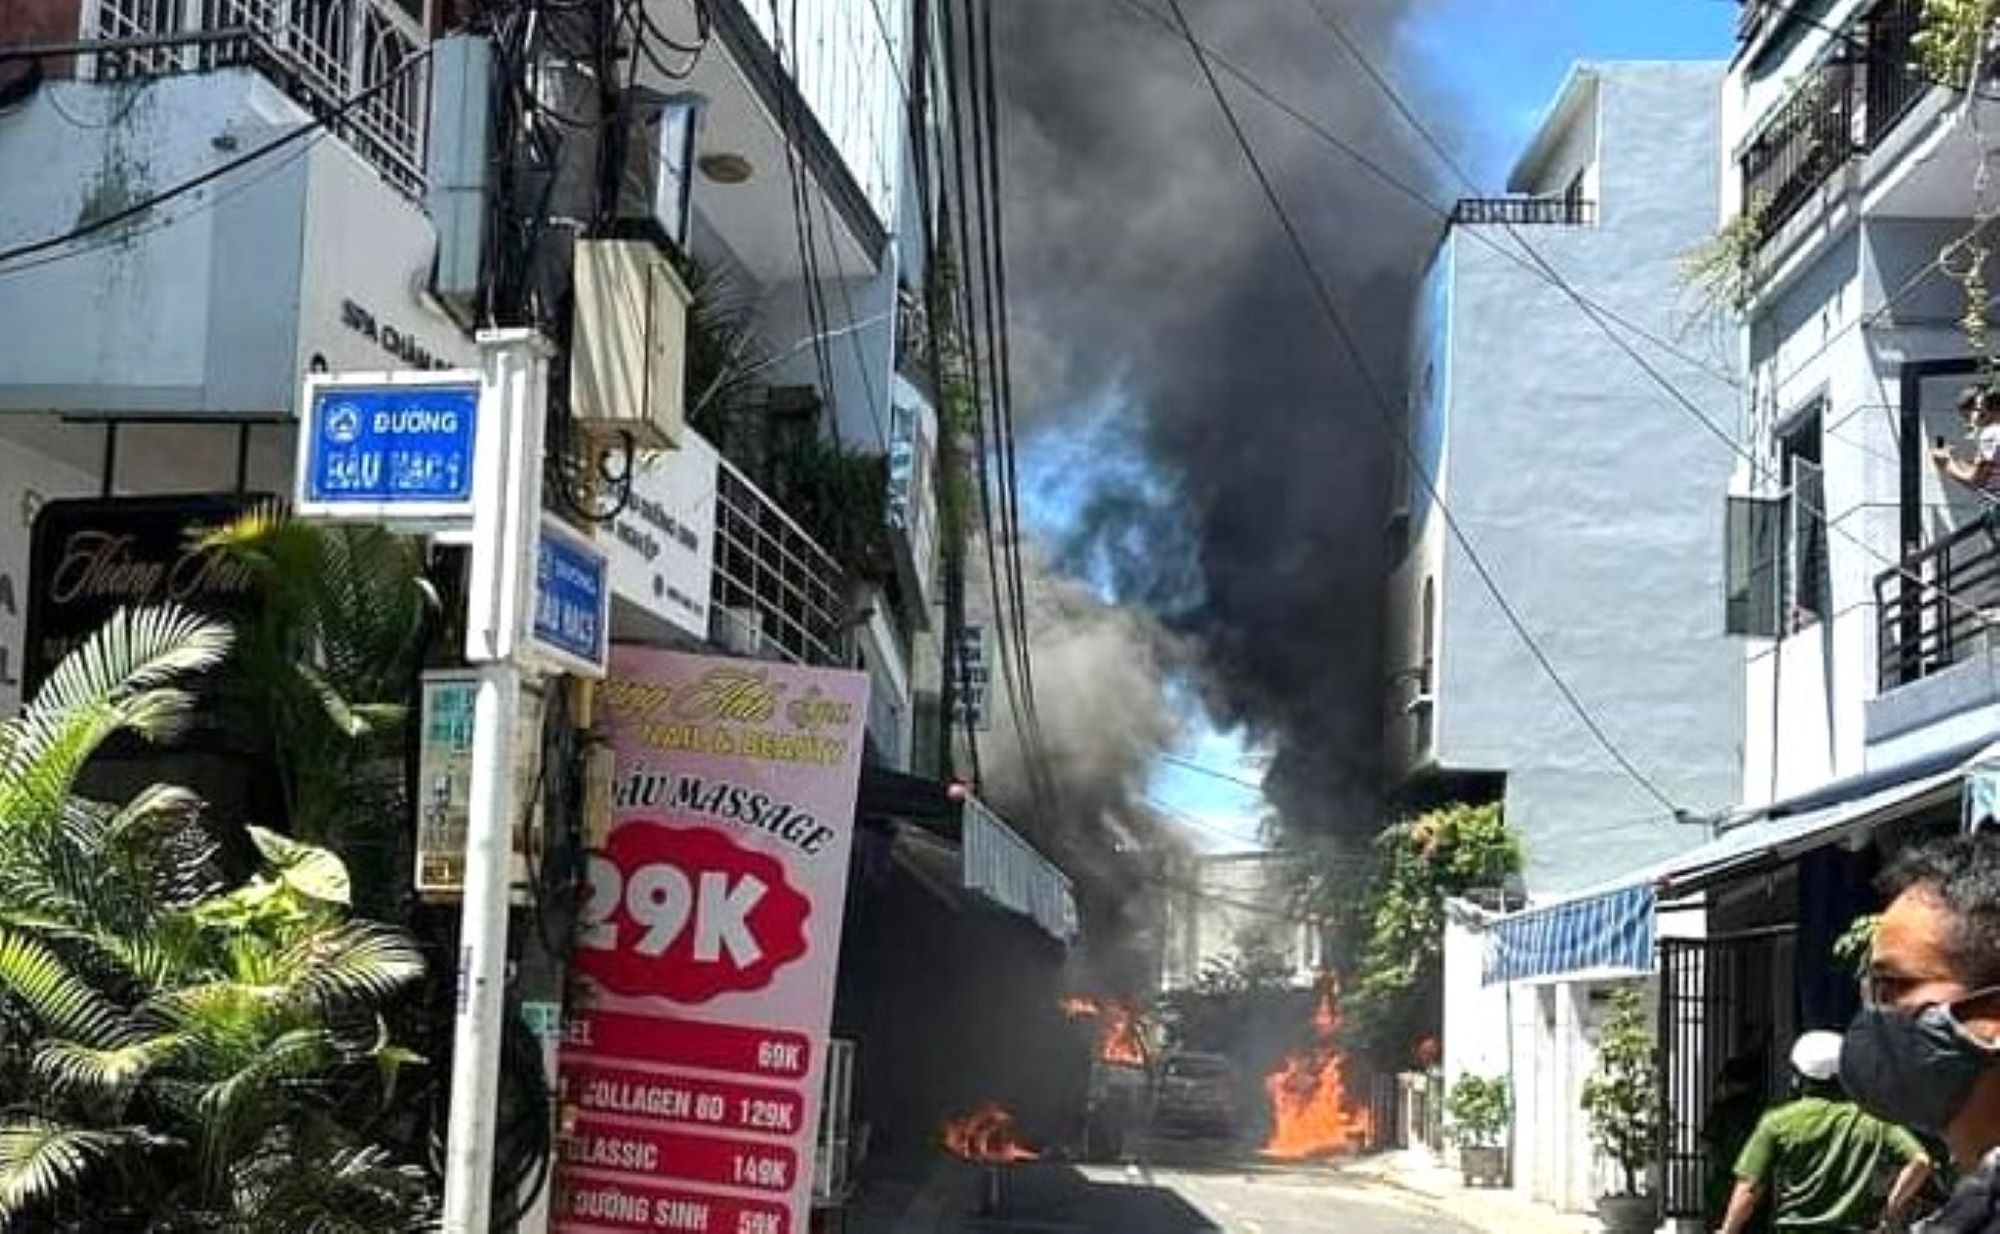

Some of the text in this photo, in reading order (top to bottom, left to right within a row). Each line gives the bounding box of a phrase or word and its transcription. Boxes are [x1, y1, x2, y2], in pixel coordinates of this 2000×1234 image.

[669, 772, 834, 856] MASSAGE
[576, 857, 769, 970] 29K
[740, 1097, 794, 1131] 129K
[733, 1155, 788, 1188] 149K
